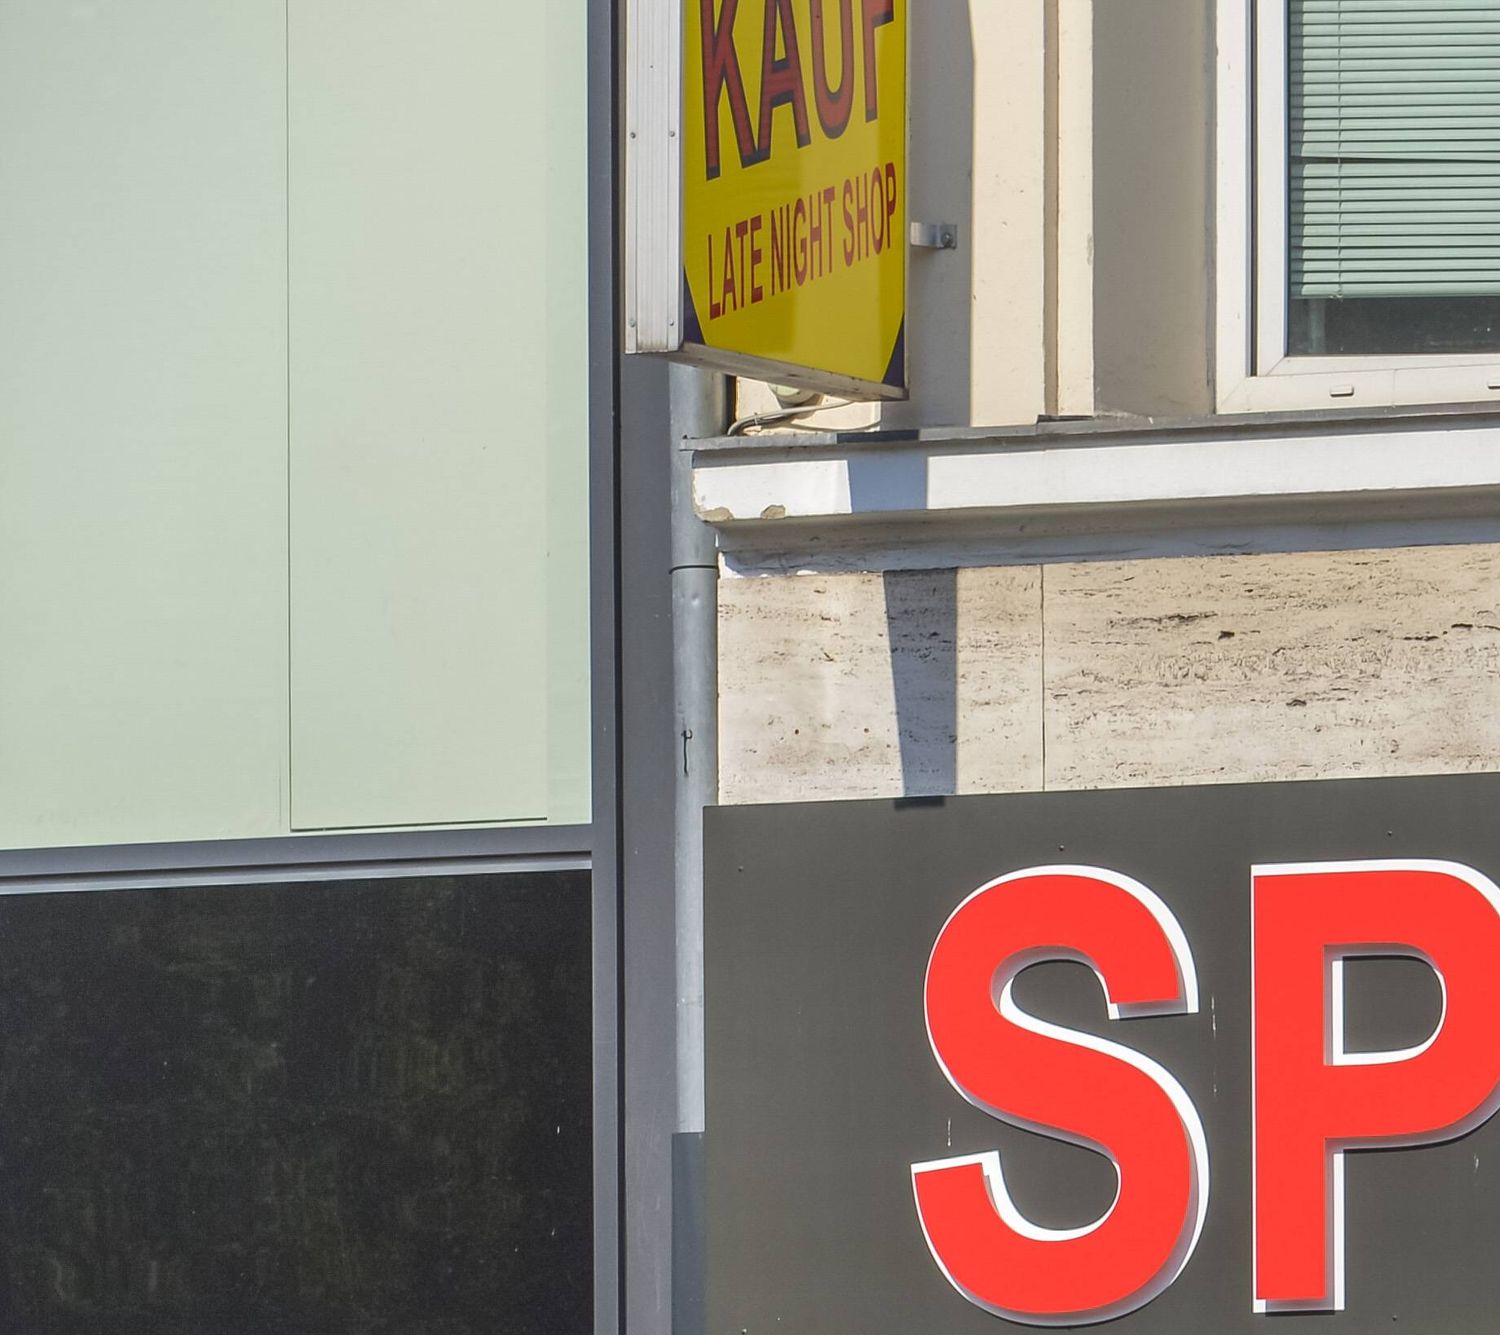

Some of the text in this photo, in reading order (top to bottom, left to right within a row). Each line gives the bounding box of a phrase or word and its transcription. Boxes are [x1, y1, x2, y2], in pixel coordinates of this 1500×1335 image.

[707, 162, 897, 320] LATE NIGHT SHOP
